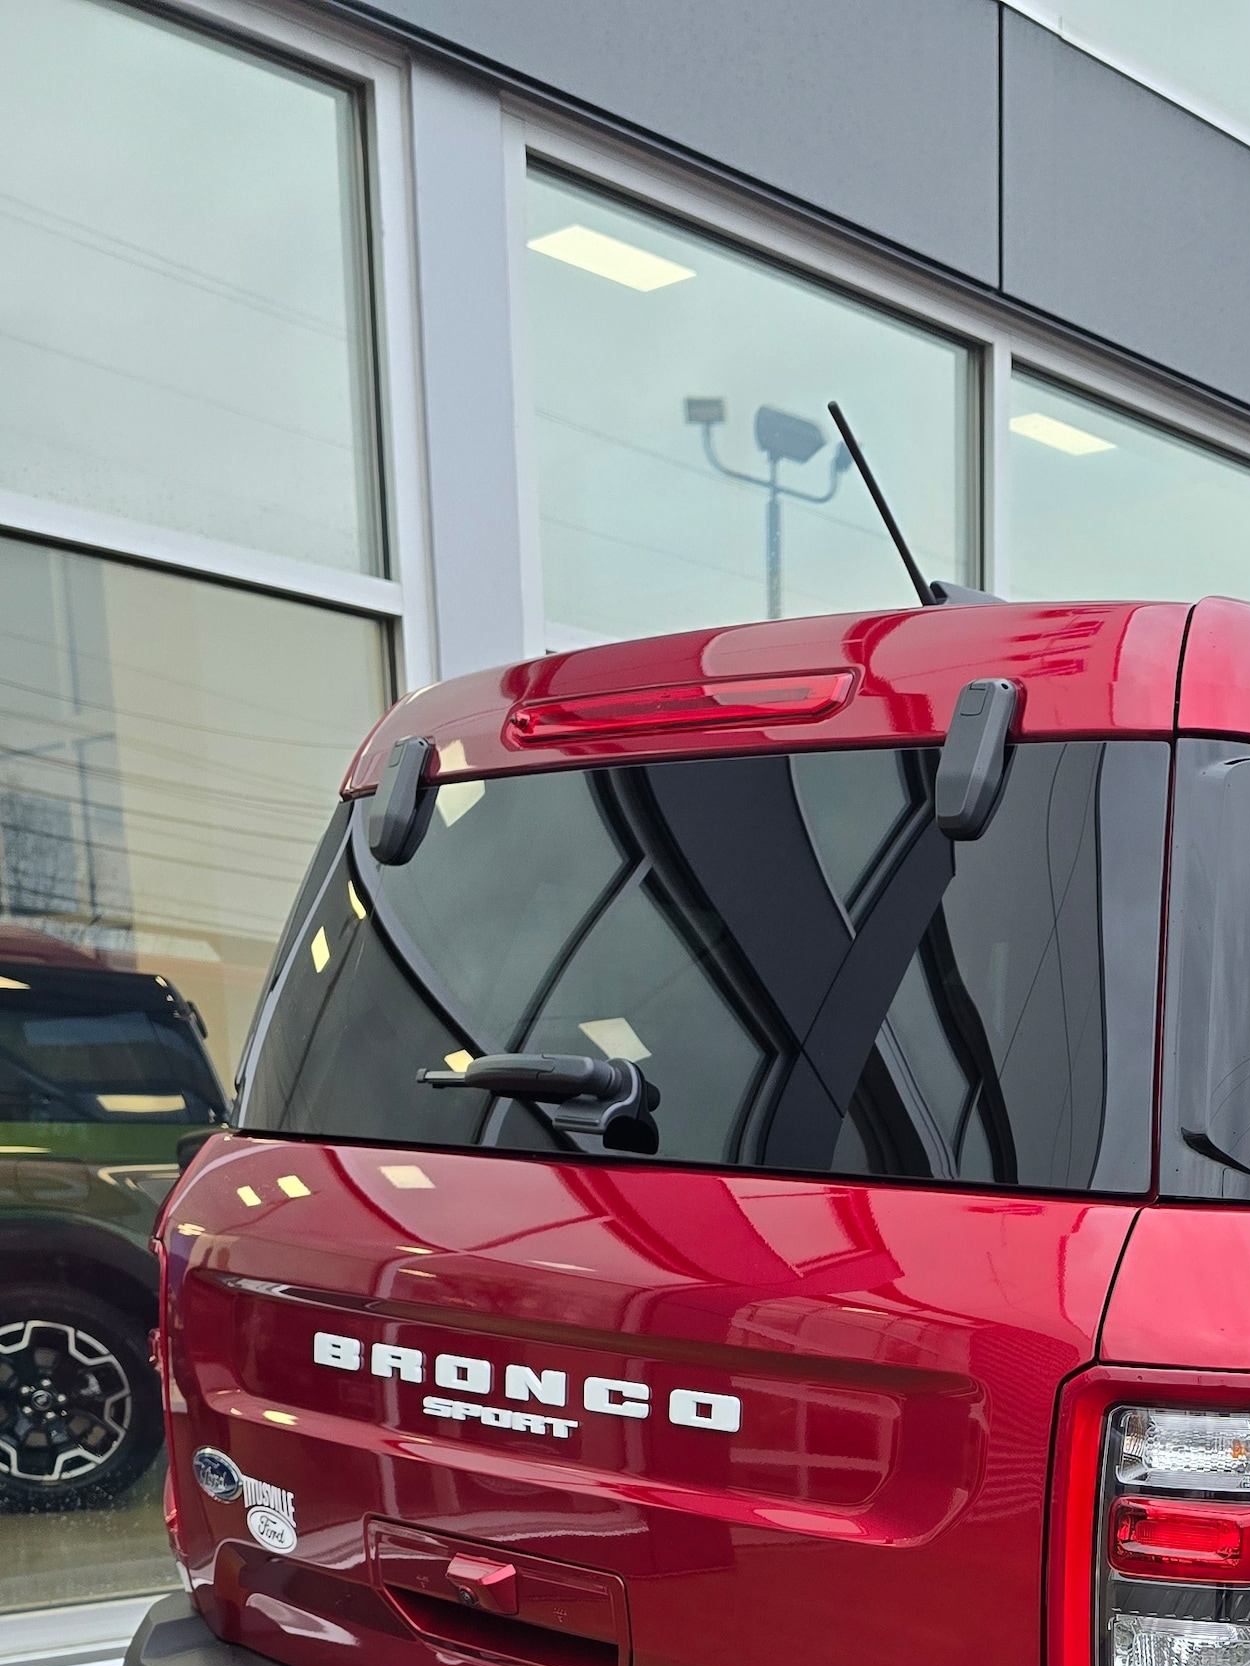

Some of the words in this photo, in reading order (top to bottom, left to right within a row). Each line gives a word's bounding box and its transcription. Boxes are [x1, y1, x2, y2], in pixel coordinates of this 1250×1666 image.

[313, 1331, 741, 1433] BRONCO
[422, 1395, 579, 1439] SPORT
[242, 1474, 297, 1528] TITUSVILLE
[257, 1514, 286, 1544] Ford
